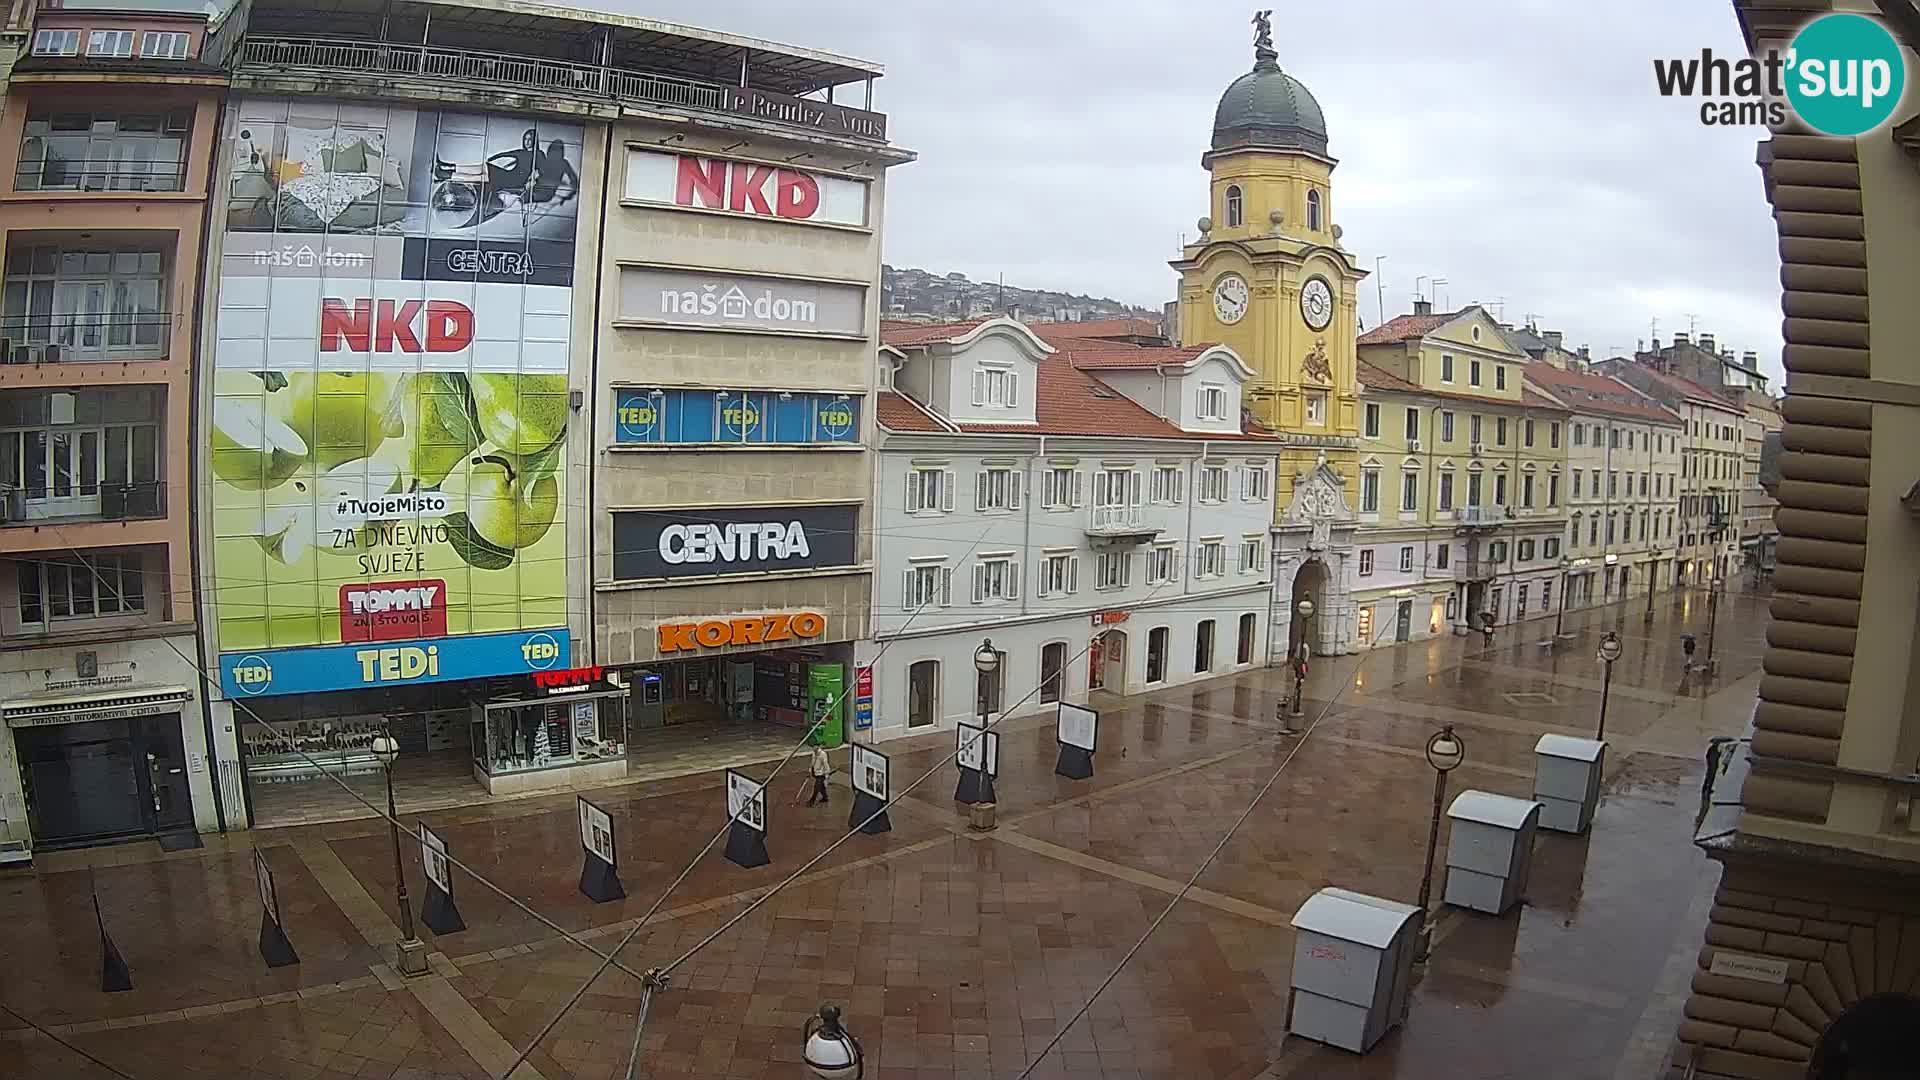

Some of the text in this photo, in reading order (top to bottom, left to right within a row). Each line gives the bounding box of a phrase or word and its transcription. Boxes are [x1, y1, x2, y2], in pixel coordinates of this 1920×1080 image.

[723, 88, 745, 111] Le
[675, 154, 820, 219] NKD
[254, 246, 364, 267] naš dom
[448, 249, 533, 276] CENTRA
[661, 284, 816, 321] naš dom
[319, 297, 476, 353] NKD
[618, 409, 657, 425] TEDi
[723, 408, 760, 425] TEDi
[819, 410, 853, 426] TEDi
[337, 496, 445, 516] #TvojeMisto
[333, 523, 449, 548] ZA DNEVNO
[658, 521, 811, 564] CENTRA
[359, 547, 425, 575] SVJEŽE
[348, 586, 438, 614] TOMMY
[658, 612, 825, 653] KORZO
[357, 645, 440, 682] TEDi
[521, 643, 559, 661] TEDi
[232, 664, 272, 684] TEDi
